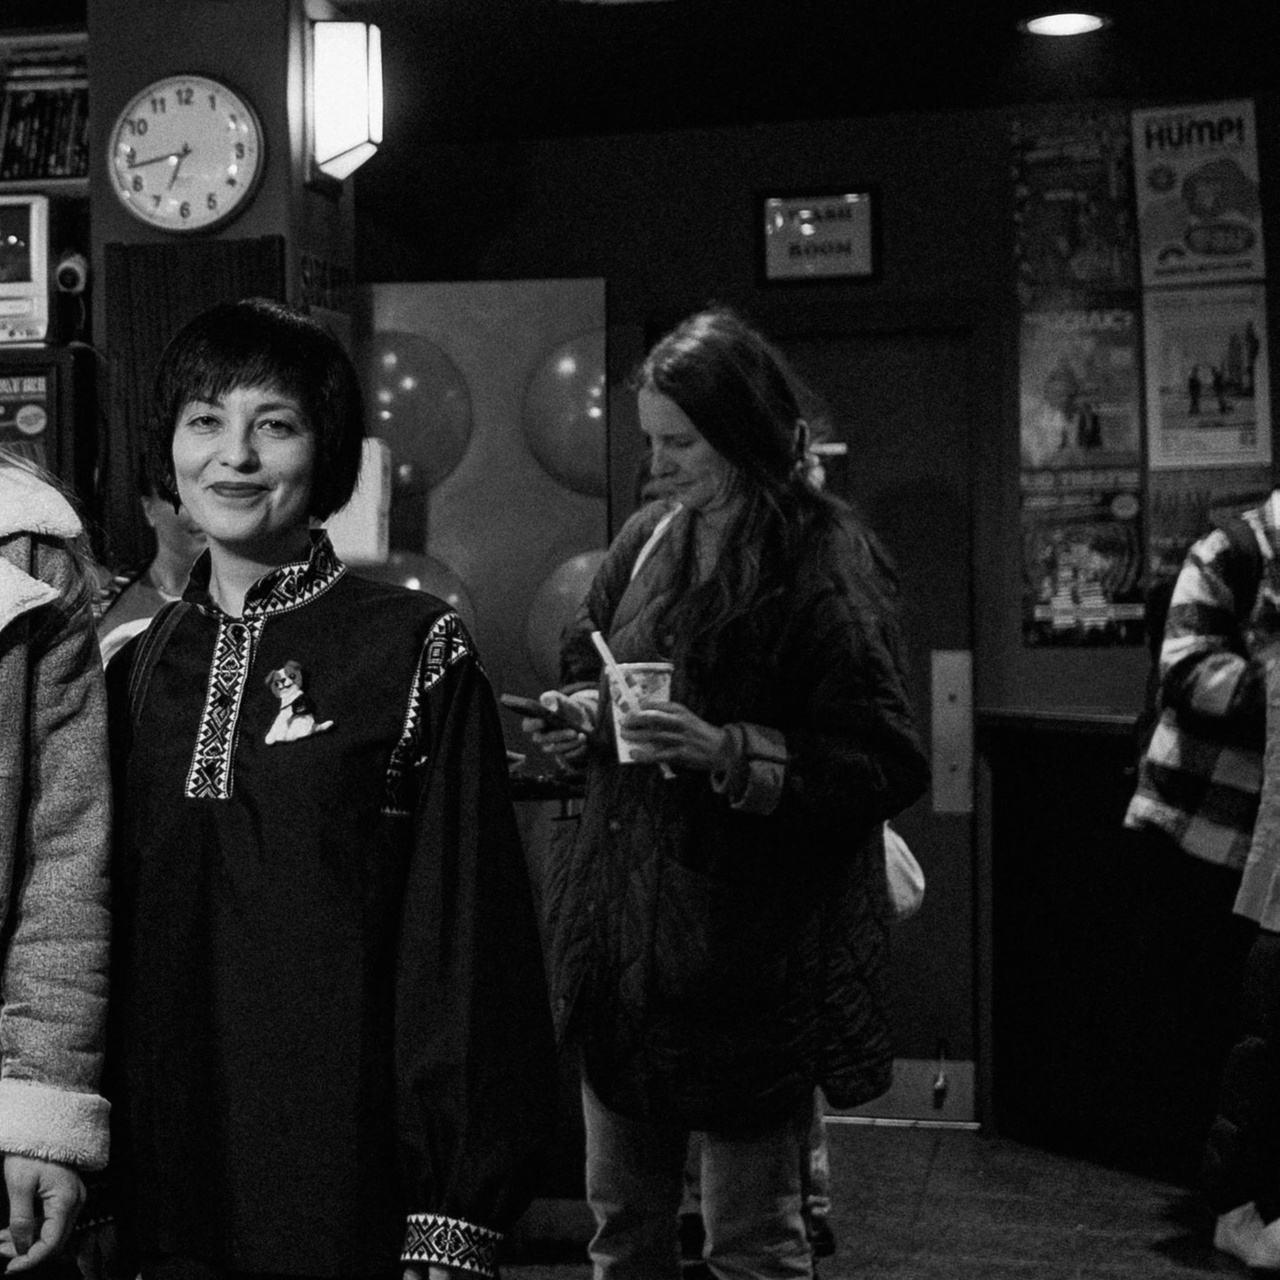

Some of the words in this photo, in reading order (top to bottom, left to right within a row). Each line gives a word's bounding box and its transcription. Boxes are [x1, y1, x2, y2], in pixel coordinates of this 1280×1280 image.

[150, 97, 166, 114] 11
[176, 87, 194, 106] 12
[208, 94, 217, 111] 1
[127, 117, 148, 136] 10
[235, 142, 245, 160] 3
[152, 193, 162, 208] 7
[179, 201, 191, 219] 6
